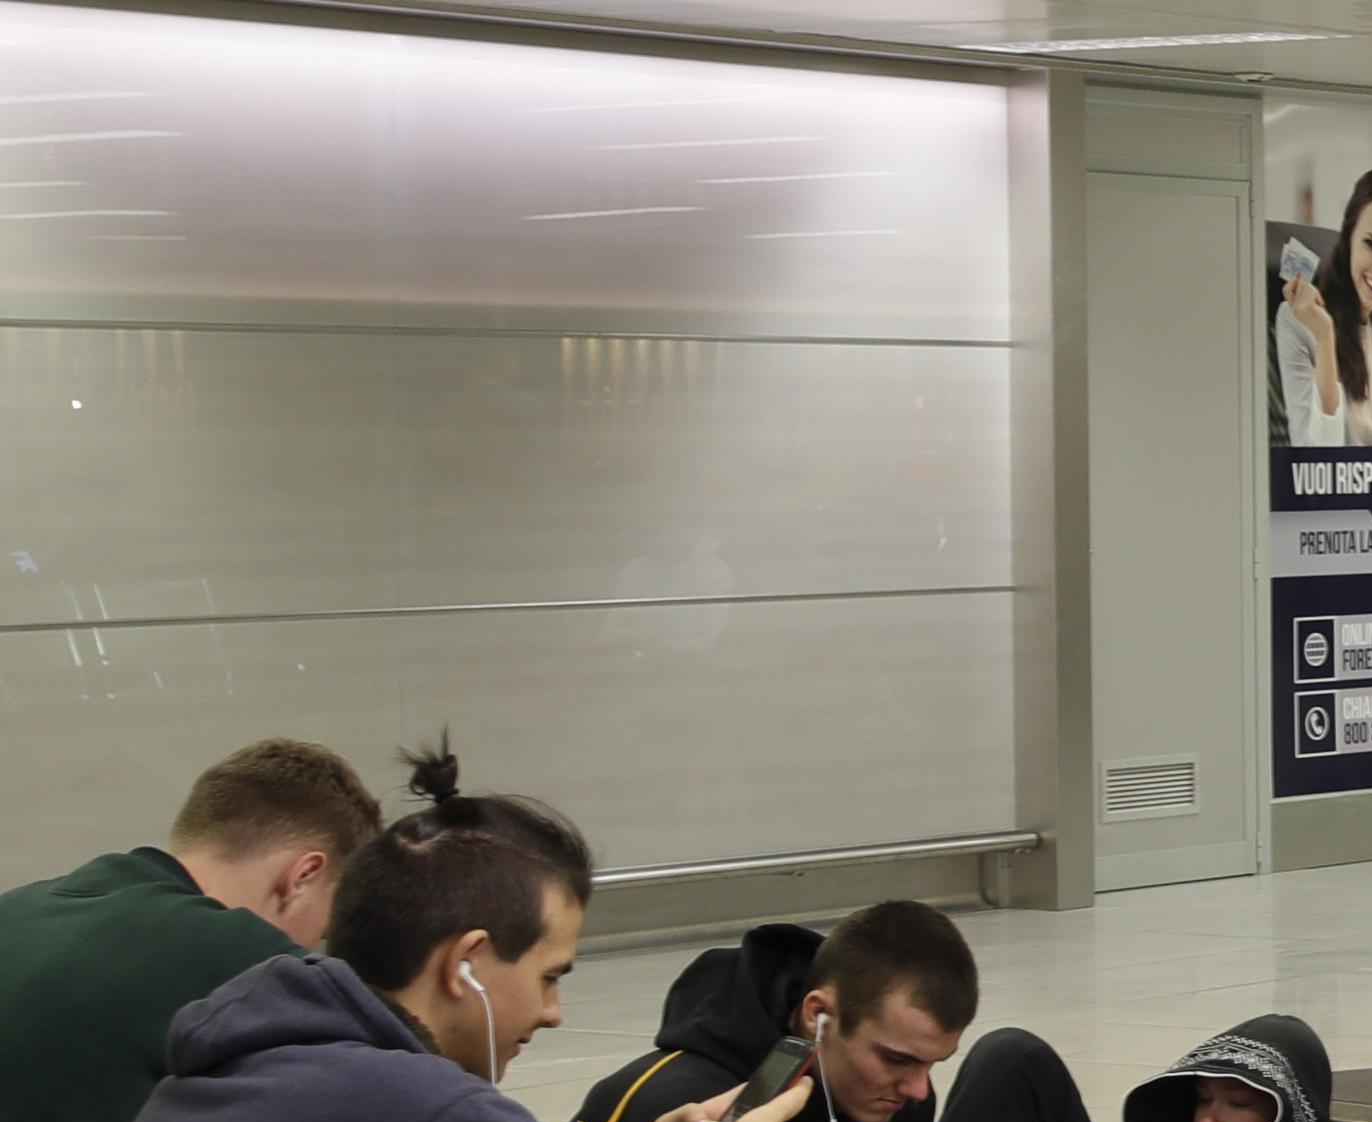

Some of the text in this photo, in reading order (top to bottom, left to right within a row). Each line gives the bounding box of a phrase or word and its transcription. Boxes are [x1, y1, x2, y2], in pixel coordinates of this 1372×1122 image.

[1292, 462, 1333, 495] VUOI
[1300, 530, 1356, 555] PRENOTA
[1344, 721, 1368, 745] 800
